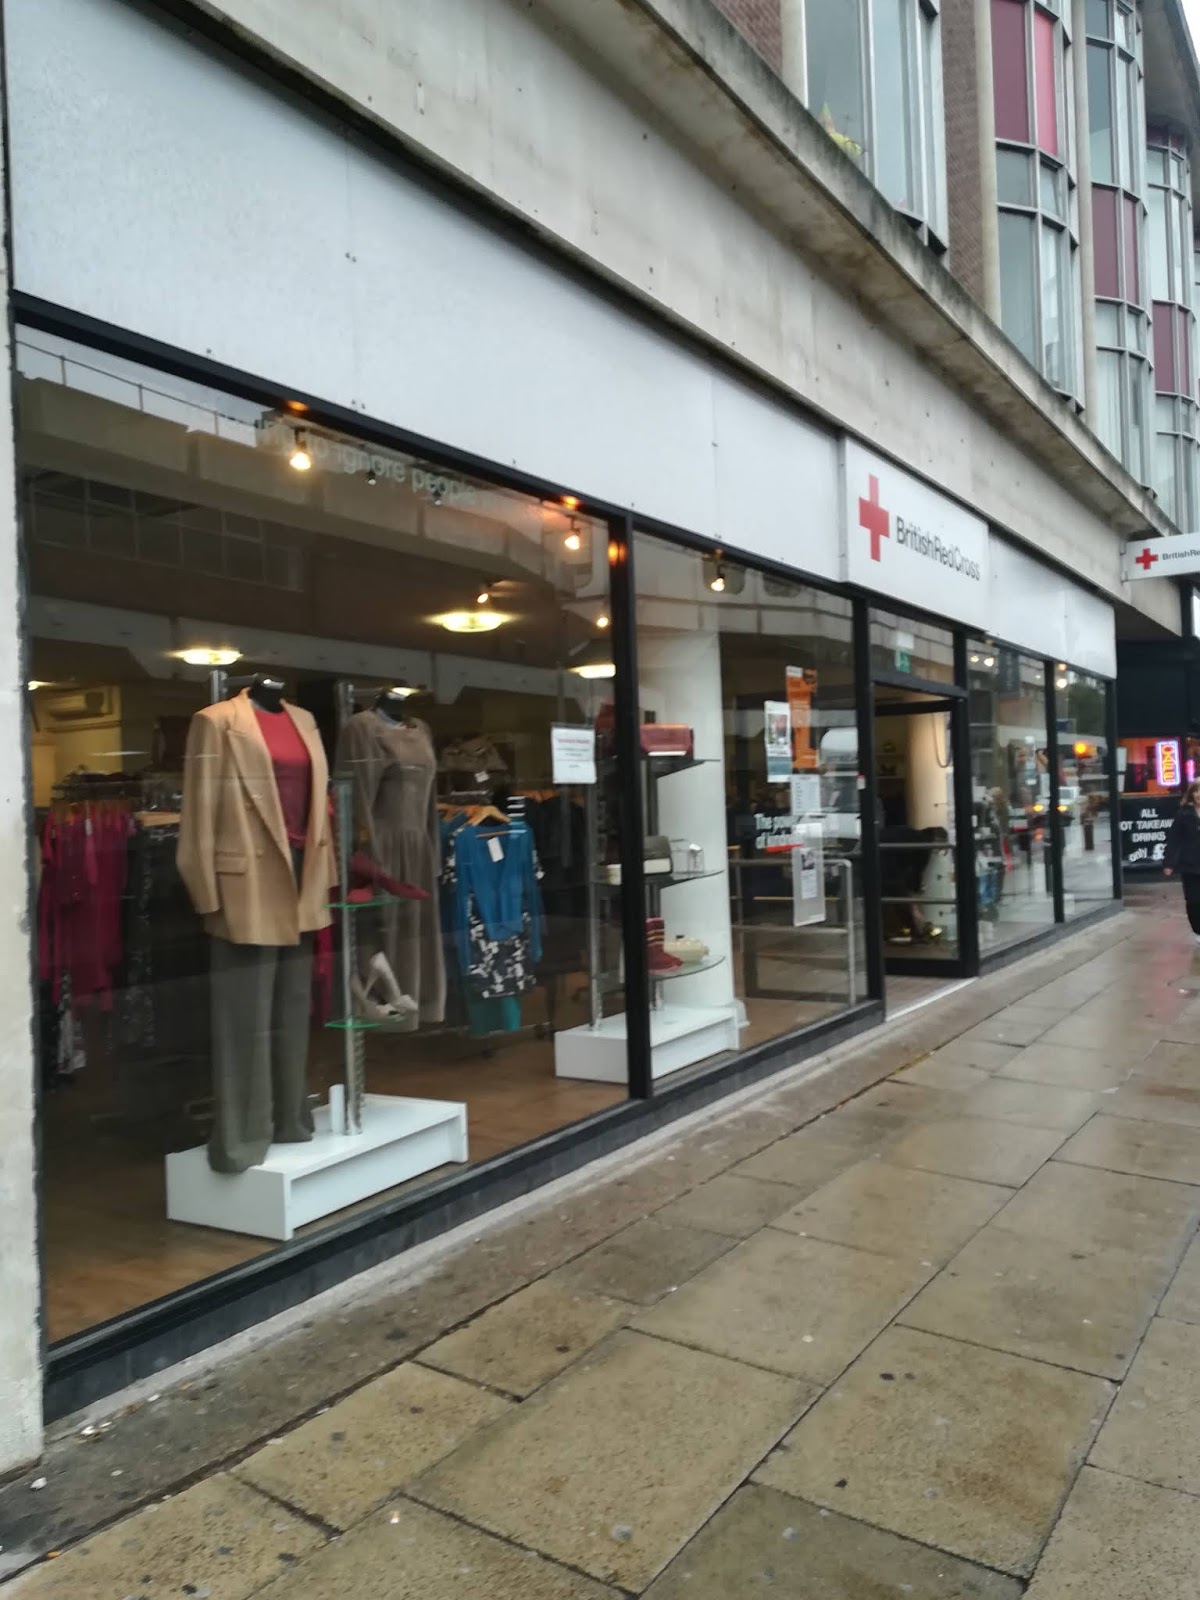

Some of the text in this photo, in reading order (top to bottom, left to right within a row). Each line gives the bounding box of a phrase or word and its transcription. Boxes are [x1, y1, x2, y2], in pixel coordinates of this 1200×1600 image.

[896, 515, 980, 581] BritishRedCross
[1141, 808, 1158, 818] ALL
[1120, 819, 1174, 831] OT TAKEAW
[1132, 831, 1166, 843] DRINKS
[1130, 848, 1148, 862] only
